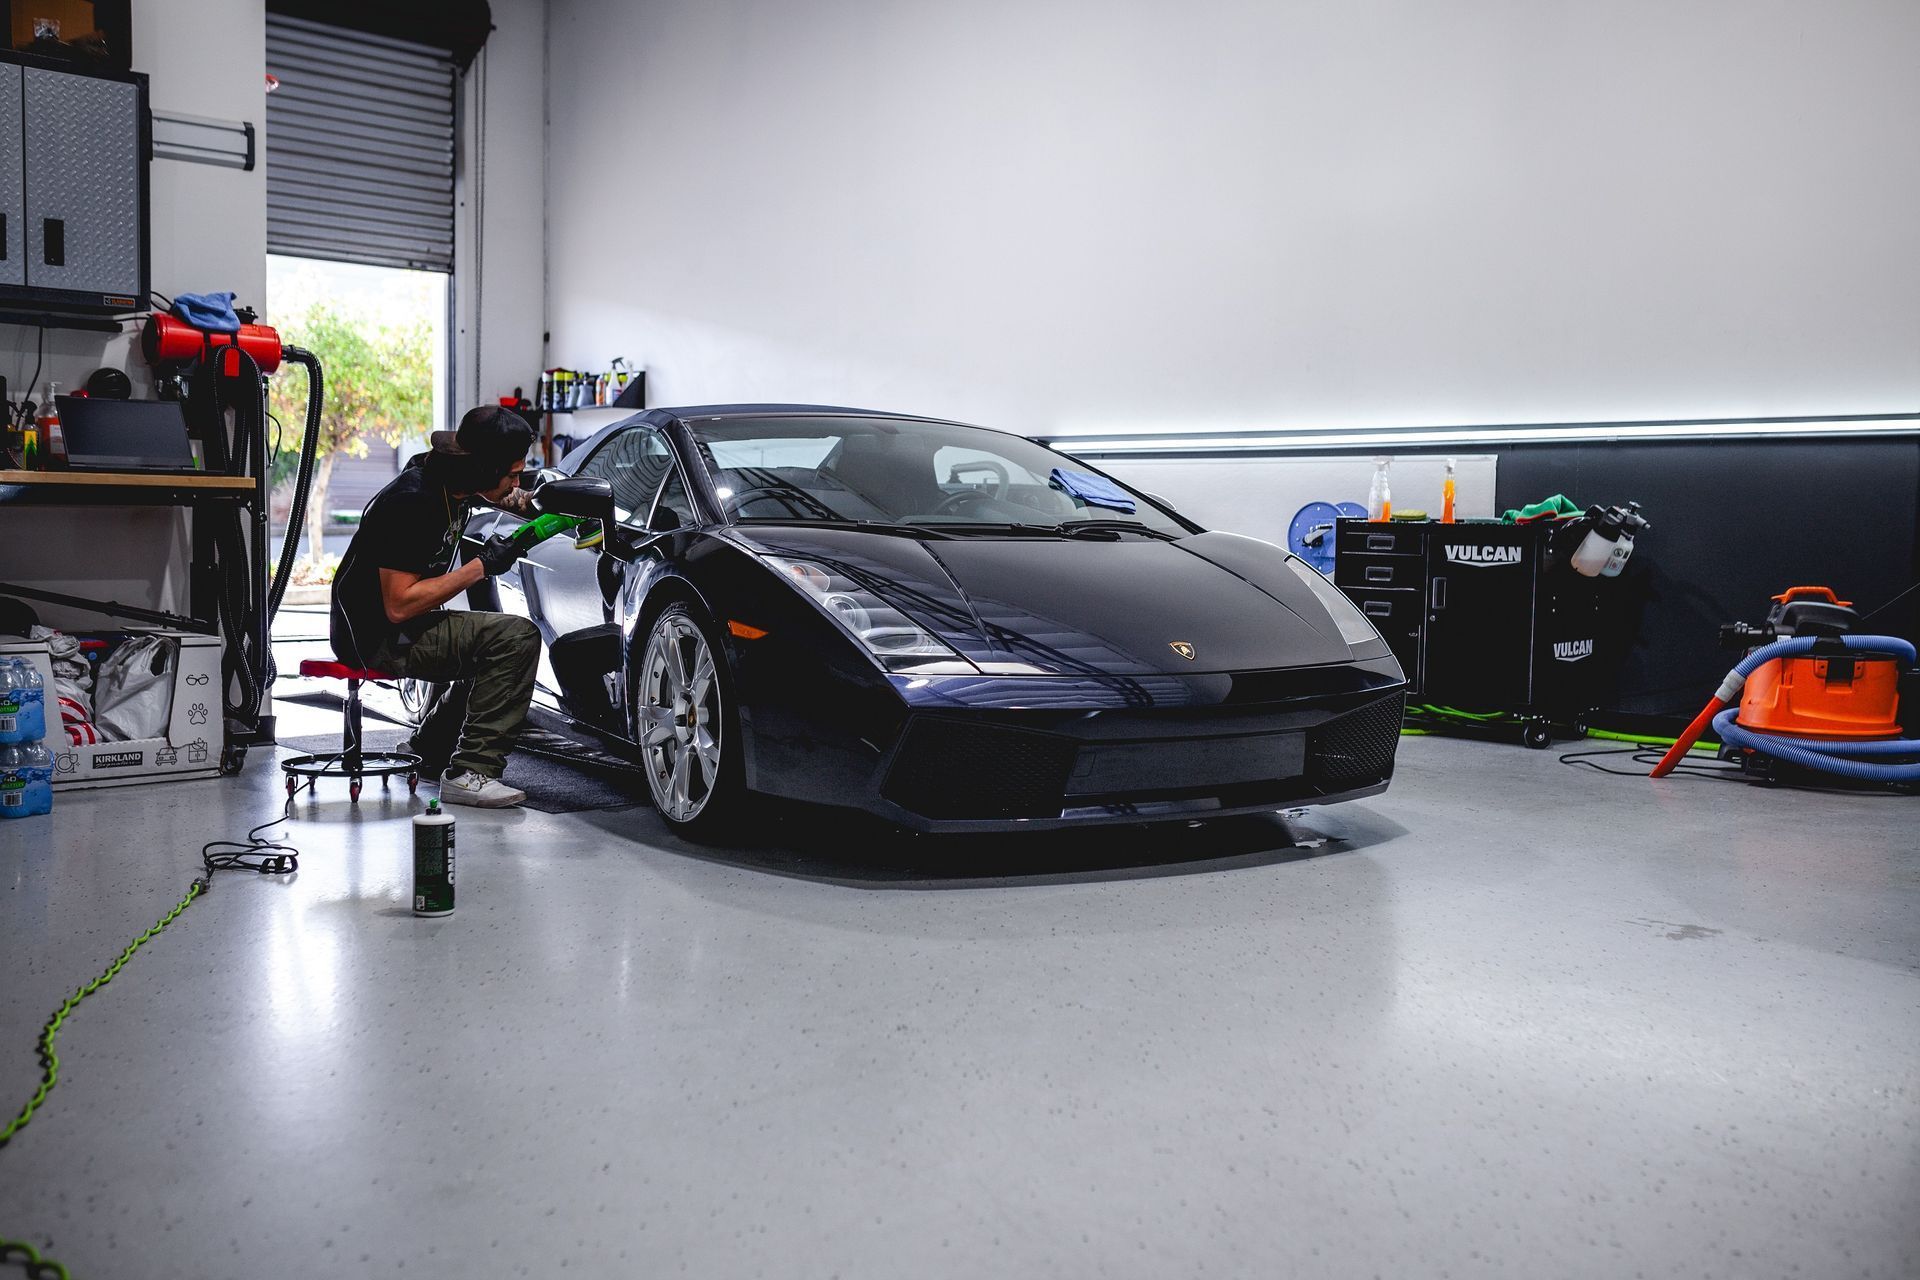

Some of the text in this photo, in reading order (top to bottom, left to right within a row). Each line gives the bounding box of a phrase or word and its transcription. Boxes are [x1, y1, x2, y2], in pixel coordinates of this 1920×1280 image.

[1444, 544, 1521, 562] VULCAN
[1554, 639, 1592, 658] VULCAN
[95, 753, 141, 763] KIRKLAND
